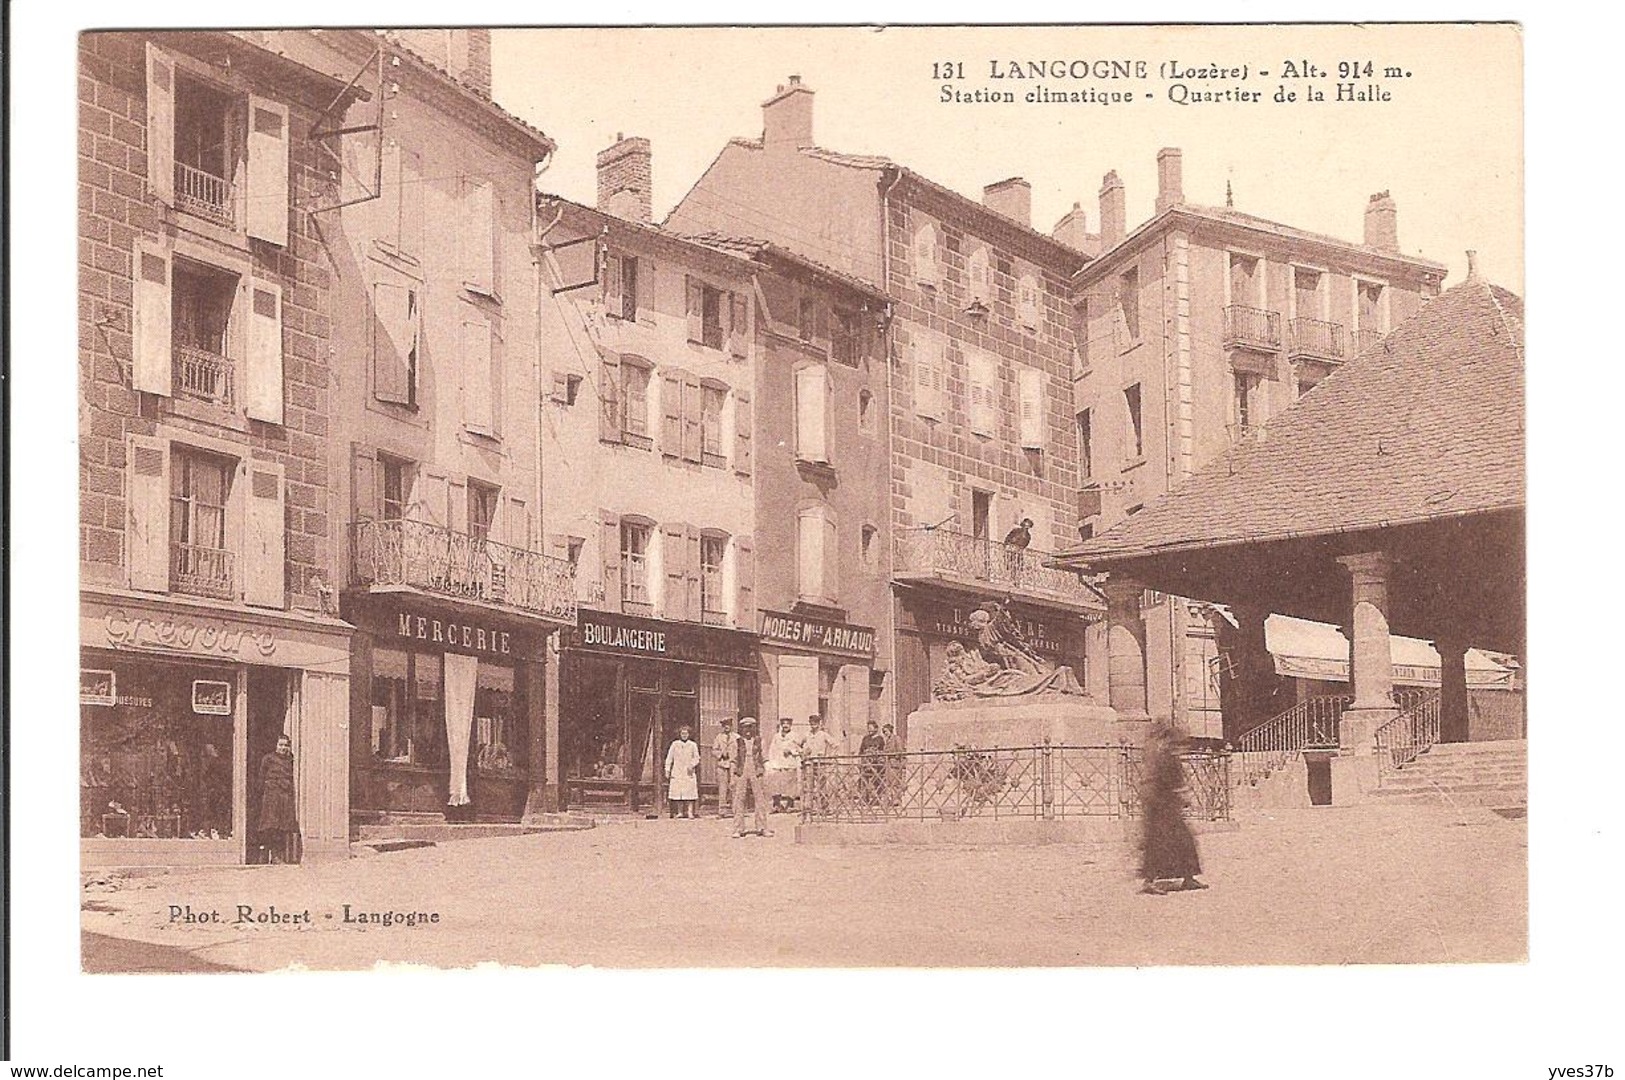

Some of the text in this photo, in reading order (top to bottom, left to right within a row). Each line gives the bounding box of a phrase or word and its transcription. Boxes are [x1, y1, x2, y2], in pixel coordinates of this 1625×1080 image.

[398, 613, 511, 654] MERCERIE
[584, 622, 667, 652] BOULANGERIE
[762, 615, 800, 641] MODES
[824, 627, 873, 652] ARNAUD
